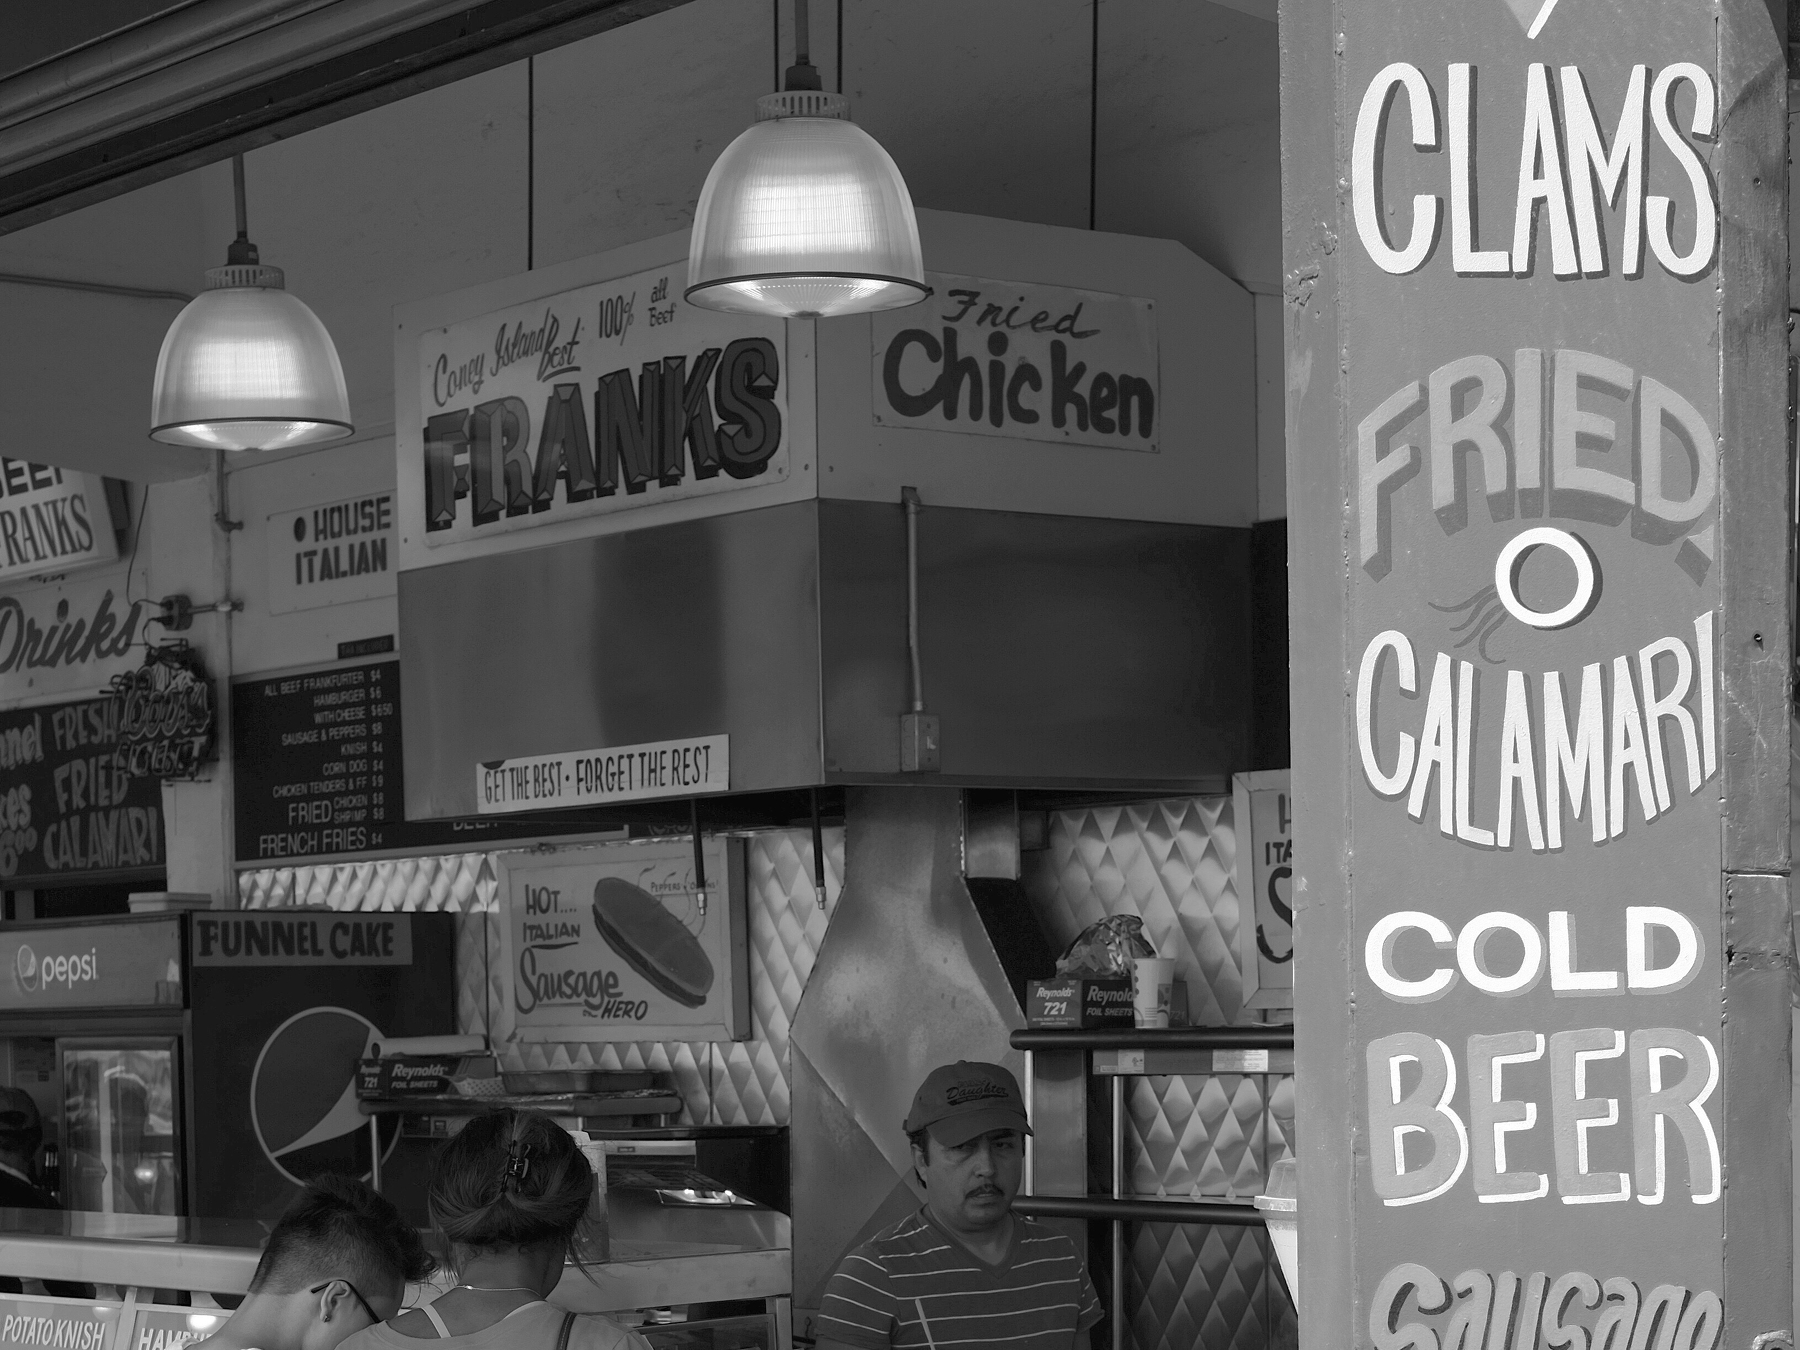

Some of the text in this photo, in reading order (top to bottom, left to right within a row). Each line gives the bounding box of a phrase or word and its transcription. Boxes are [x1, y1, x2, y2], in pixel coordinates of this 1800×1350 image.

[1351, 62, 1717, 283] CLAMS
[650, 276, 669, 303] all
[942, 289, 1100, 339] Fried
[599, 292, 636, 347] 100%
[433, 308, 581, 407] Coney Island Best
[883, 326, 1155, 439] Chicken
[423, 337, 782, 533] FRANKS
[1357, 348, 1717, 584] FRIED
[0, 493, 94, 568] RANKS
[313, 495, 392, 542] HOUSE
[295, 537, 387, 585] ITALIAN
[1356, 610, 1718, 853] CALAMARI
[484, 745, 712, 804] GET THE BEST FORGET THE REST
[288, 800, 332, 825] FRIED
[43, 807, 158, 870] CALAMARI
[259, 831, 318, 857] FRENCH
[322, 827, 367, 852] FRIES
[197, 919, 394, 959] FUNNEL CAKE
[522, 922, 581, 943] ITALIAN
[1365, 906, 1706, 1004] COLD
[41, 947, 99, 990] pepsi
[515, 947, 623, 1015] Sausage
[601, 999, 648, 1021] HERO
[1043, 1002, 1067, 1015] 721
[1087, 985, 1133, 1005] Reynold
[391, 1064, 445, 1080] Reynolds
[1366, 1027, 1721, 1205] BEER
[2, 1314, 106, 1350] POTATO KNISH
